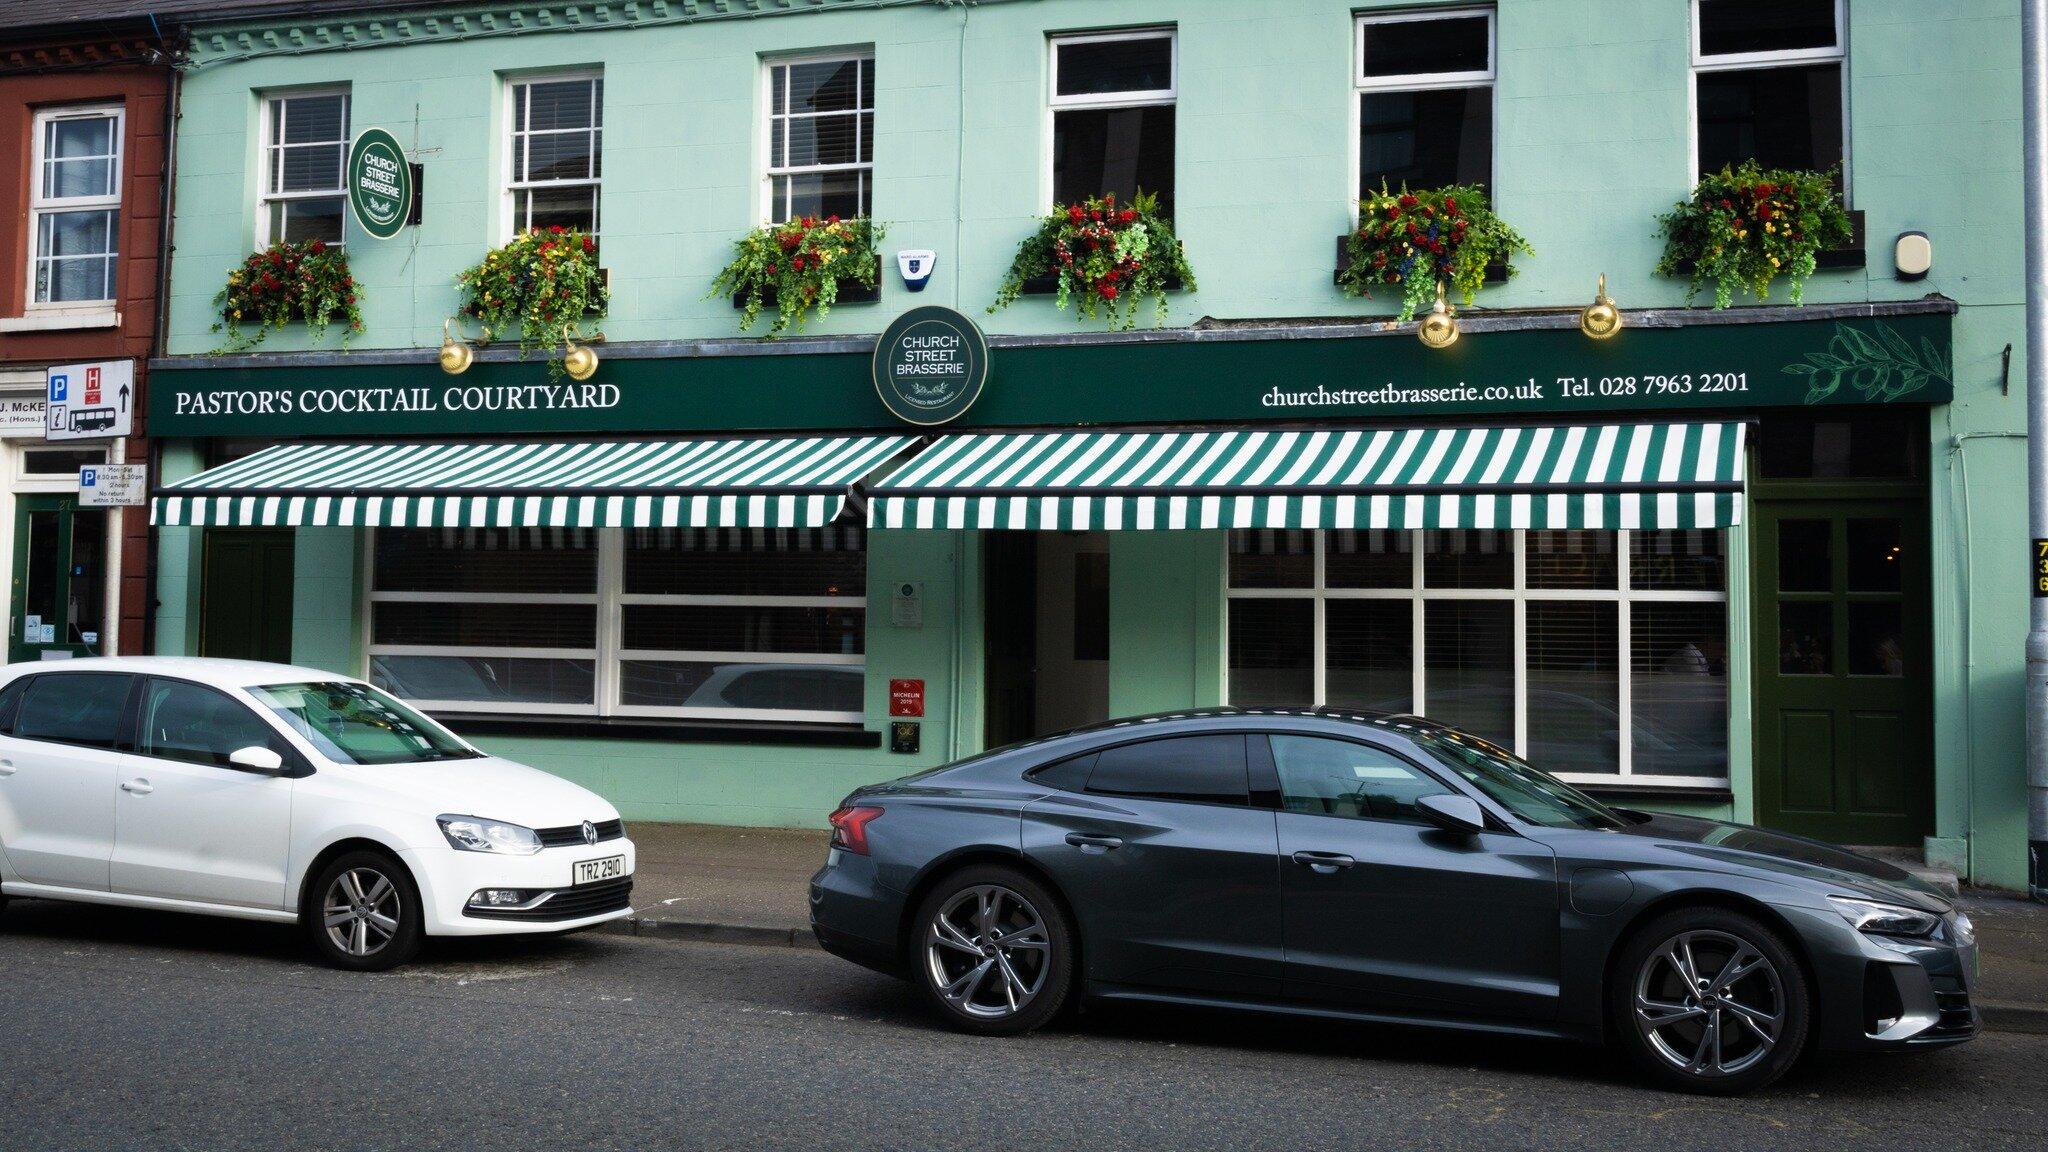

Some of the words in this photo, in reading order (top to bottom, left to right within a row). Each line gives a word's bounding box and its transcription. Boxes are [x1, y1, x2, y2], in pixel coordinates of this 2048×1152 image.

[364, 153, 397, 172] CHURCH
[366, 167, 395, 184] STREET
[360, 177, 399, 198] BRASSERIE
[902, 336, 959, 348] CHURCH
[905, 349, 956, 362] STREET
[896, 363, 964, 375] BRASSERIE
[88, 370, 99, 388] H
[54, 378, 65, 399] P
[1261, 378, 1544, 407] churchstreetbrasserie.co.uk
[1556, 377, 1595, 397] Tel.
[1600, 376, 1637, 396] 028
[1643, 374, 1692, 394] 7963
[1699, 372, 1749, 393] 2201
[175, 390, 293, 415] PASTOR'S
[299, 388, 437, 413] COCKTAIL
[443, 384, 621, 410] COURTYARD
[85, 471, 94, 485] P
[580, 862, 599, 881] TRZ
[602, 858, 620, 878] 2910
